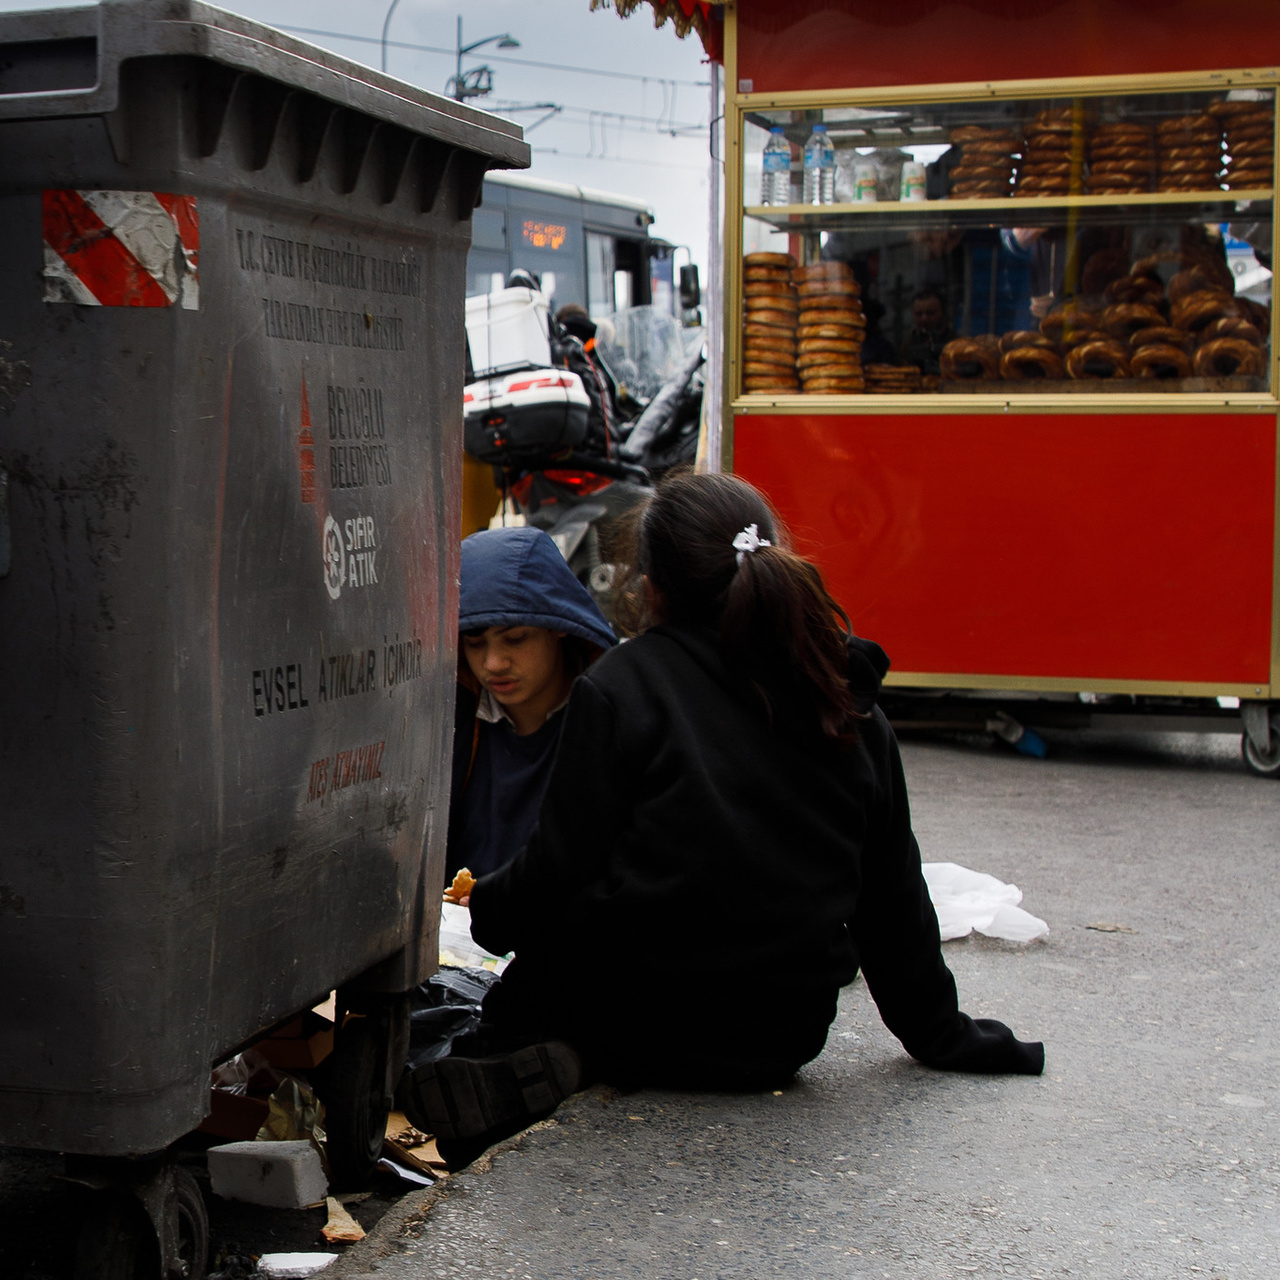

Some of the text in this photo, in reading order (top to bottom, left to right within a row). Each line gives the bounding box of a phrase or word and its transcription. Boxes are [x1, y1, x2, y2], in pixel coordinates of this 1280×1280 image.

[327, 376, 385, 440] BEYOĞLU
[330, 443, 392, 489] BELEDİYESİ
[345, 516, 375, 551] SIFIR
[349, 552, 378, 588] ATIK
[252, 629, 422, 718] EVSEL ATIKLAR İÇİNDİR
[307, 757, 330, 807] ATEŞ
